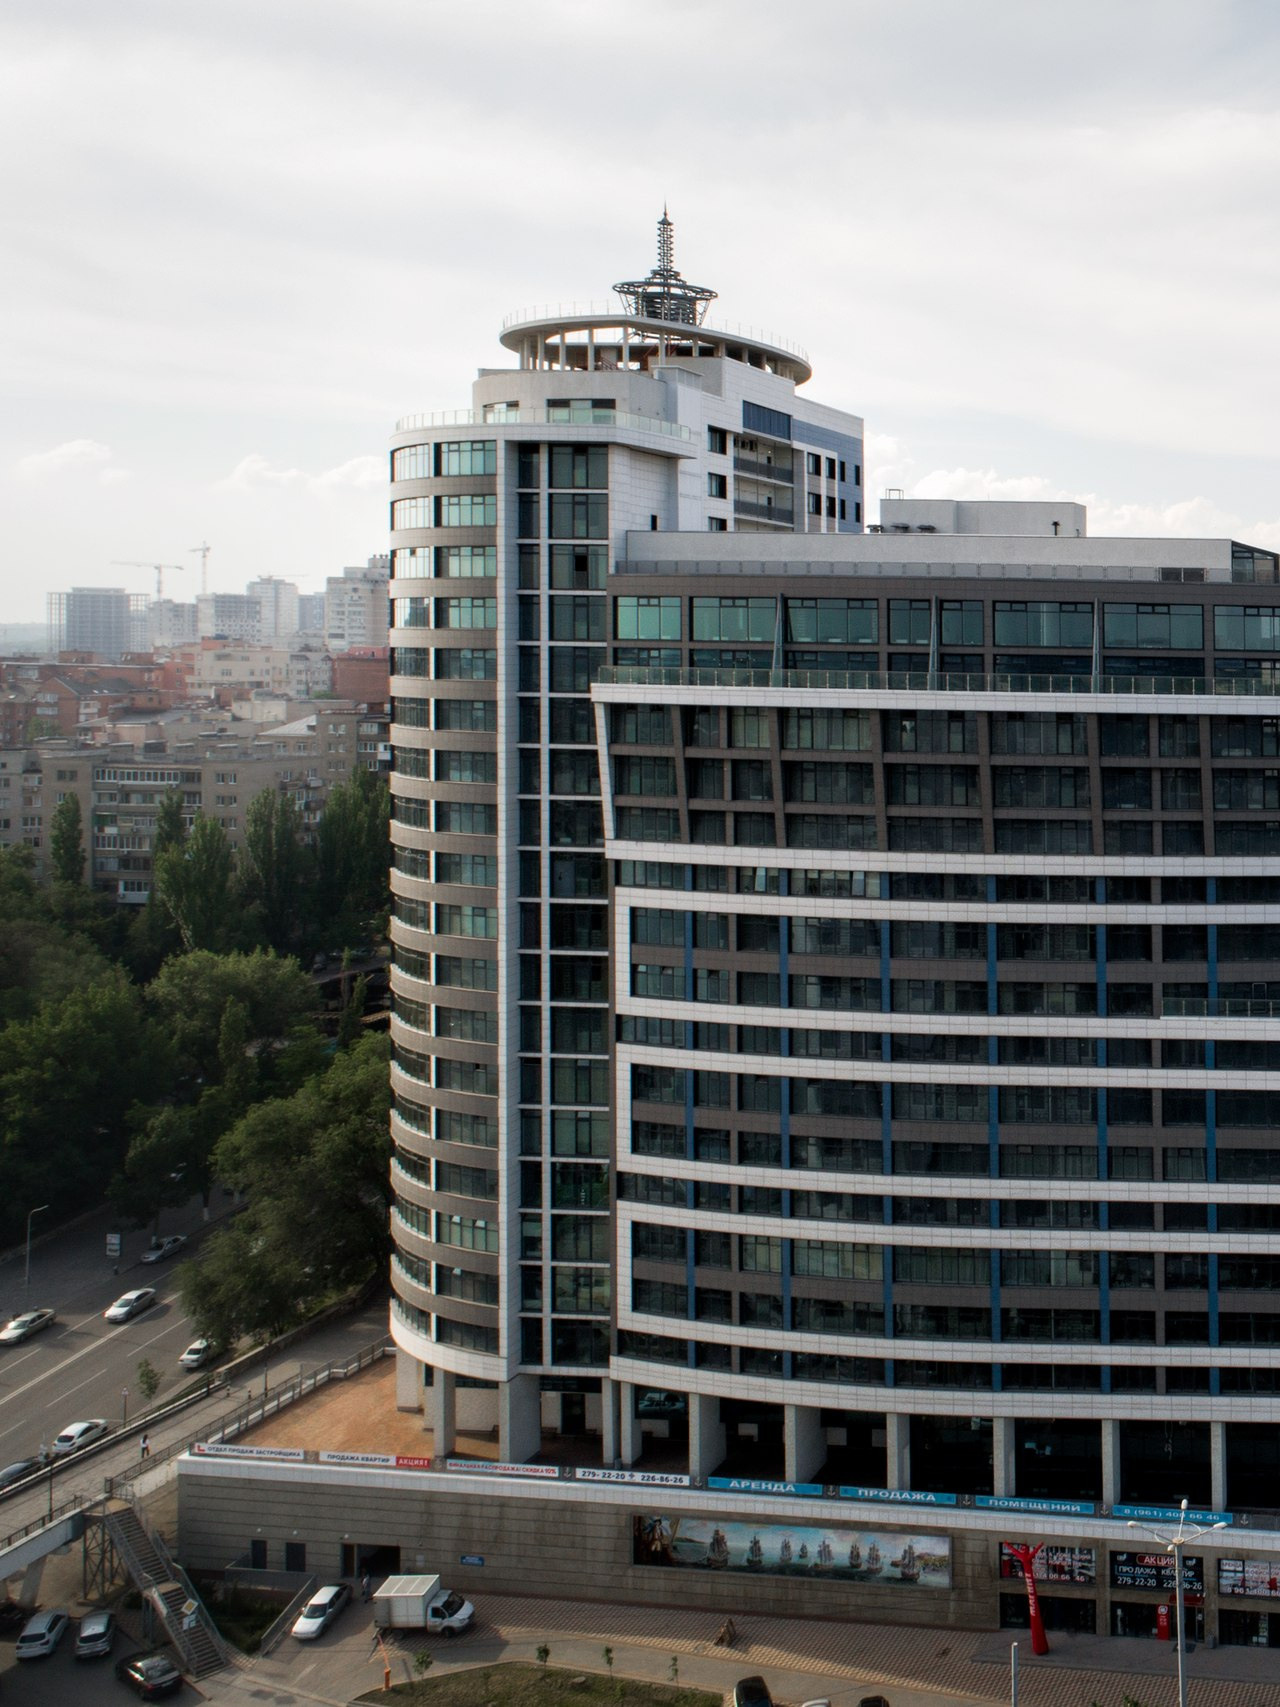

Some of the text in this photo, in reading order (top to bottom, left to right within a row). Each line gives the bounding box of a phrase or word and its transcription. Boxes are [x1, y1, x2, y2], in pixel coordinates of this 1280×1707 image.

[255, 1449, 301, 1457] ЗАСТРОЙЩИКА
[327, 1453, 390, 1464] ПРОДАЖА КВАРТИР
[729, 1479, 796, 1493] АРЕНДА
[858, 1488, 936, 1502] ПРОДАЖА
[988, 1499, 1081, 1512] ПОМЕЩЕНИЙ
[1134, 1509, 1162, 1517] (961)
[1025, 1572, 1036, 1617] МАГНИТ
